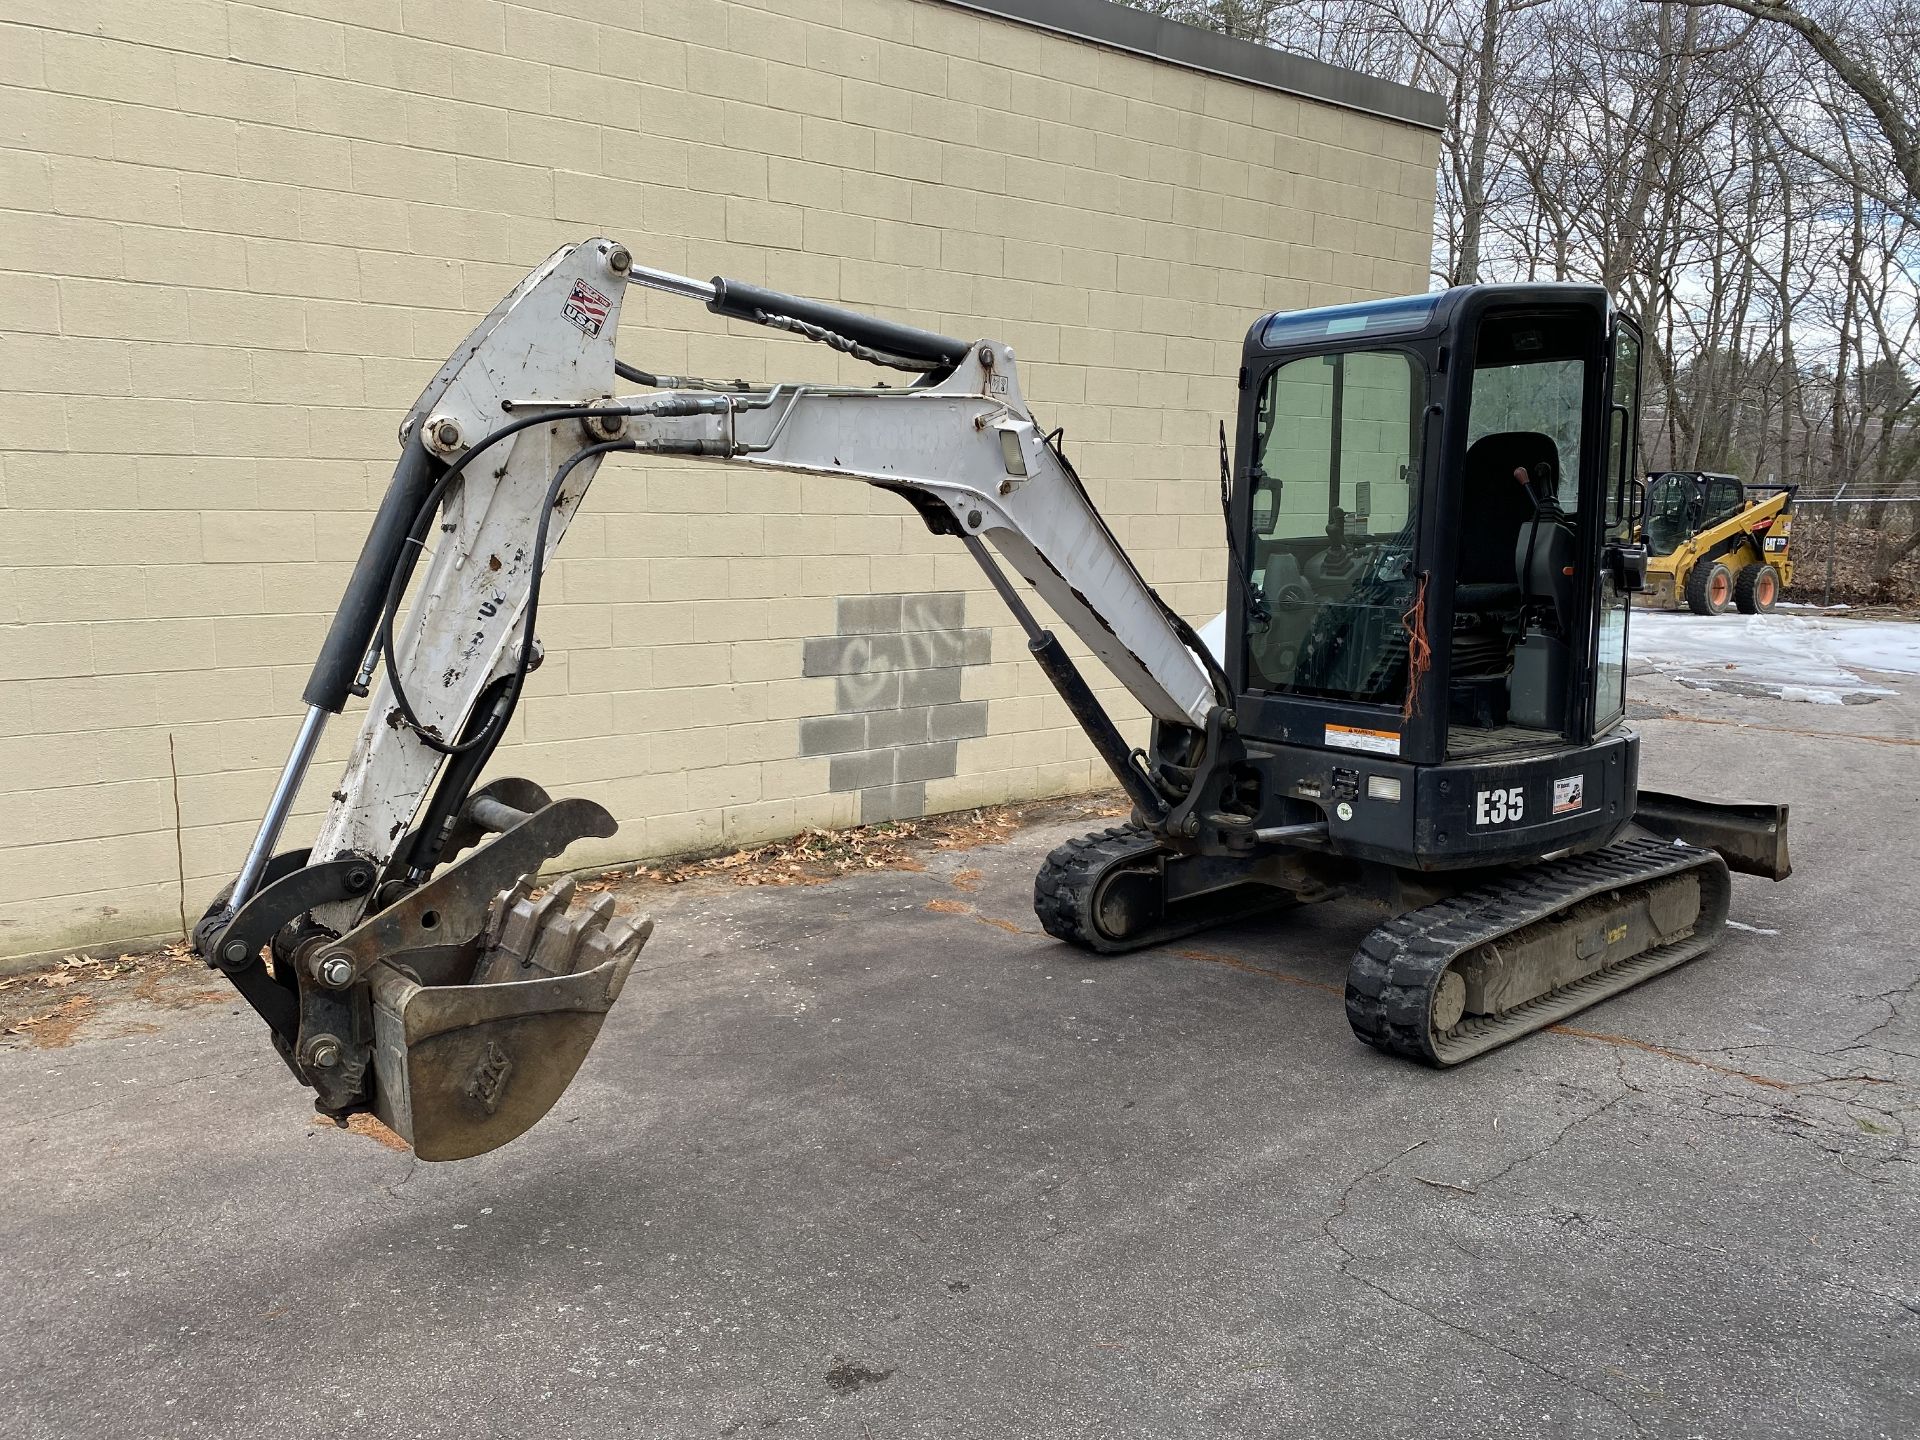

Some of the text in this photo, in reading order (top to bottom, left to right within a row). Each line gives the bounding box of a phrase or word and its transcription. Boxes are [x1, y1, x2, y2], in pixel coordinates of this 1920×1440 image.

[565, 305, 596, 333] USA
[1353, 728, 1376, 736] WARNING
[1476, 787, 1524, 825] E35
